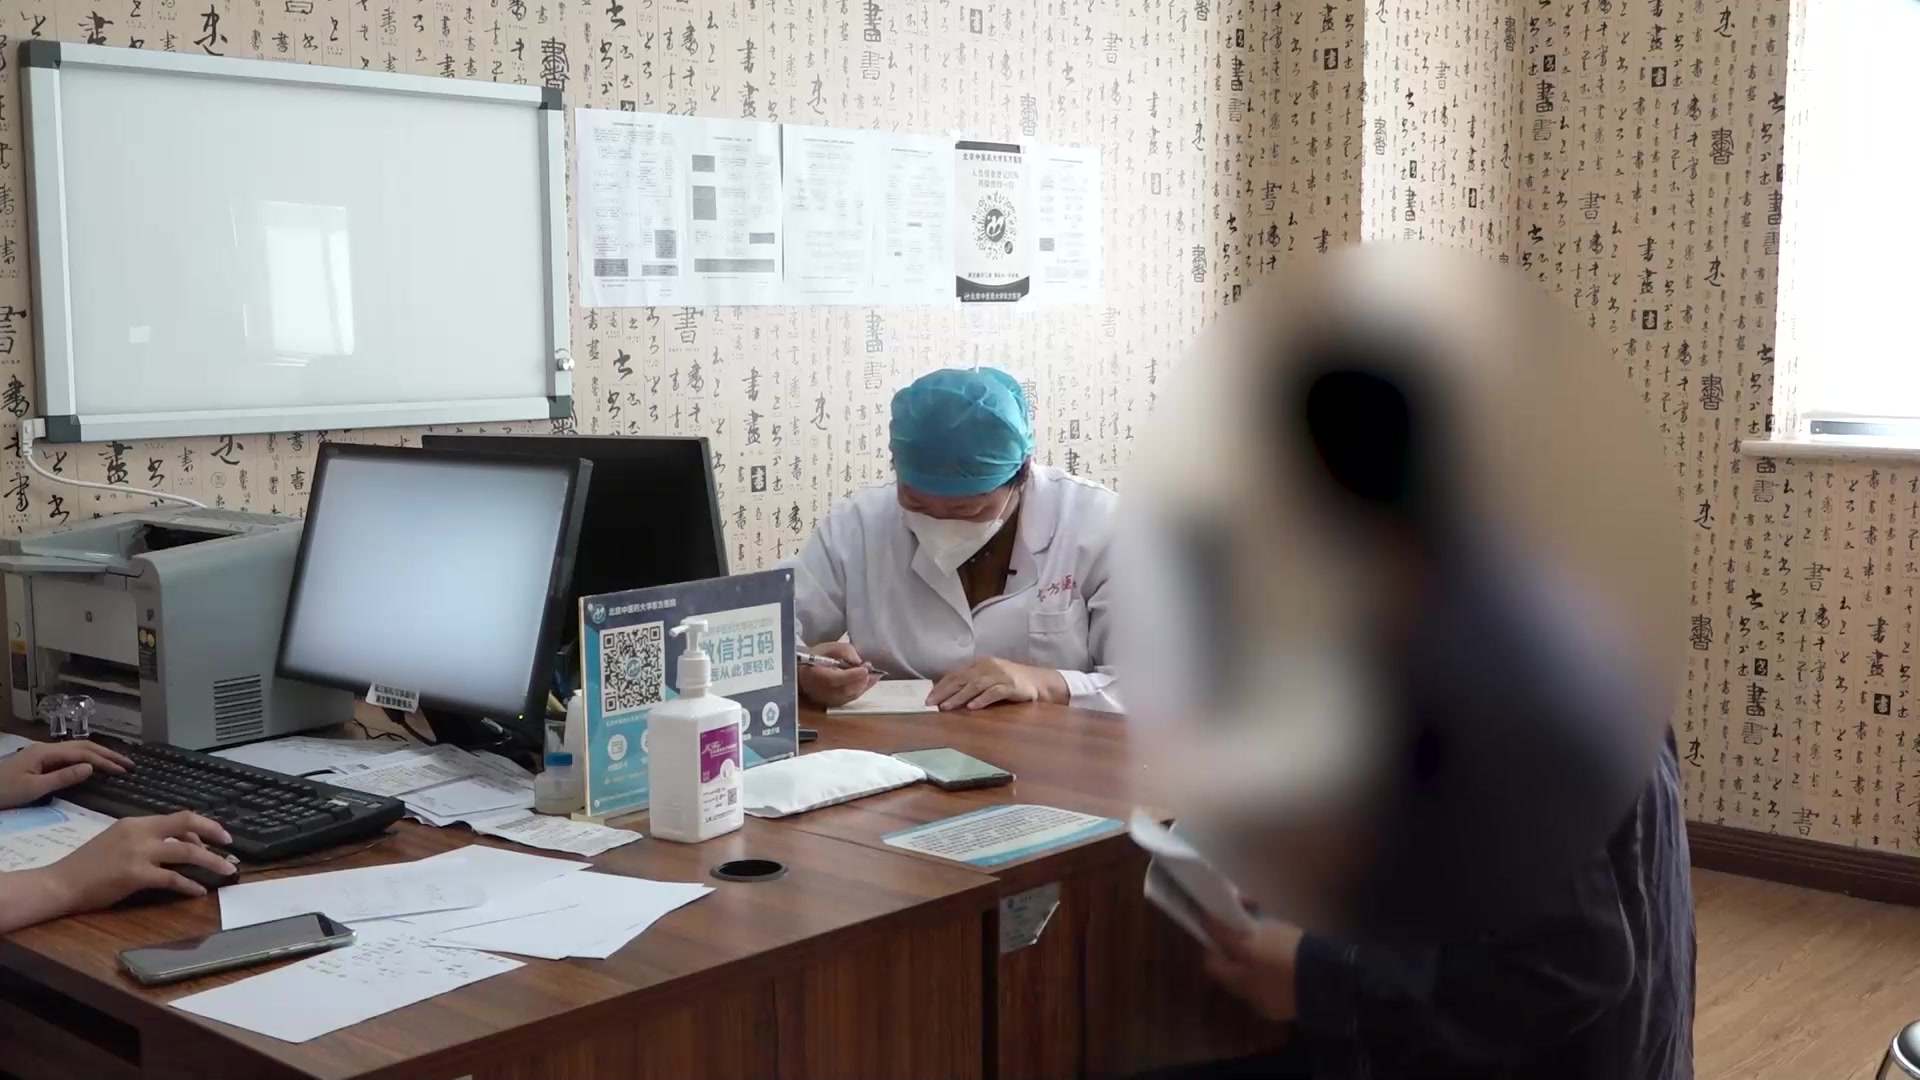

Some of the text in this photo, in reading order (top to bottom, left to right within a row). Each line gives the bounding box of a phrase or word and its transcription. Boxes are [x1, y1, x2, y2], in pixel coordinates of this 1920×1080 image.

[608, 598, 677, 616] 北京中医药大学东方医院
[698, 630, 775, 664] 微信扫码
[711, 657, 775, 682] 医从此更轻松
